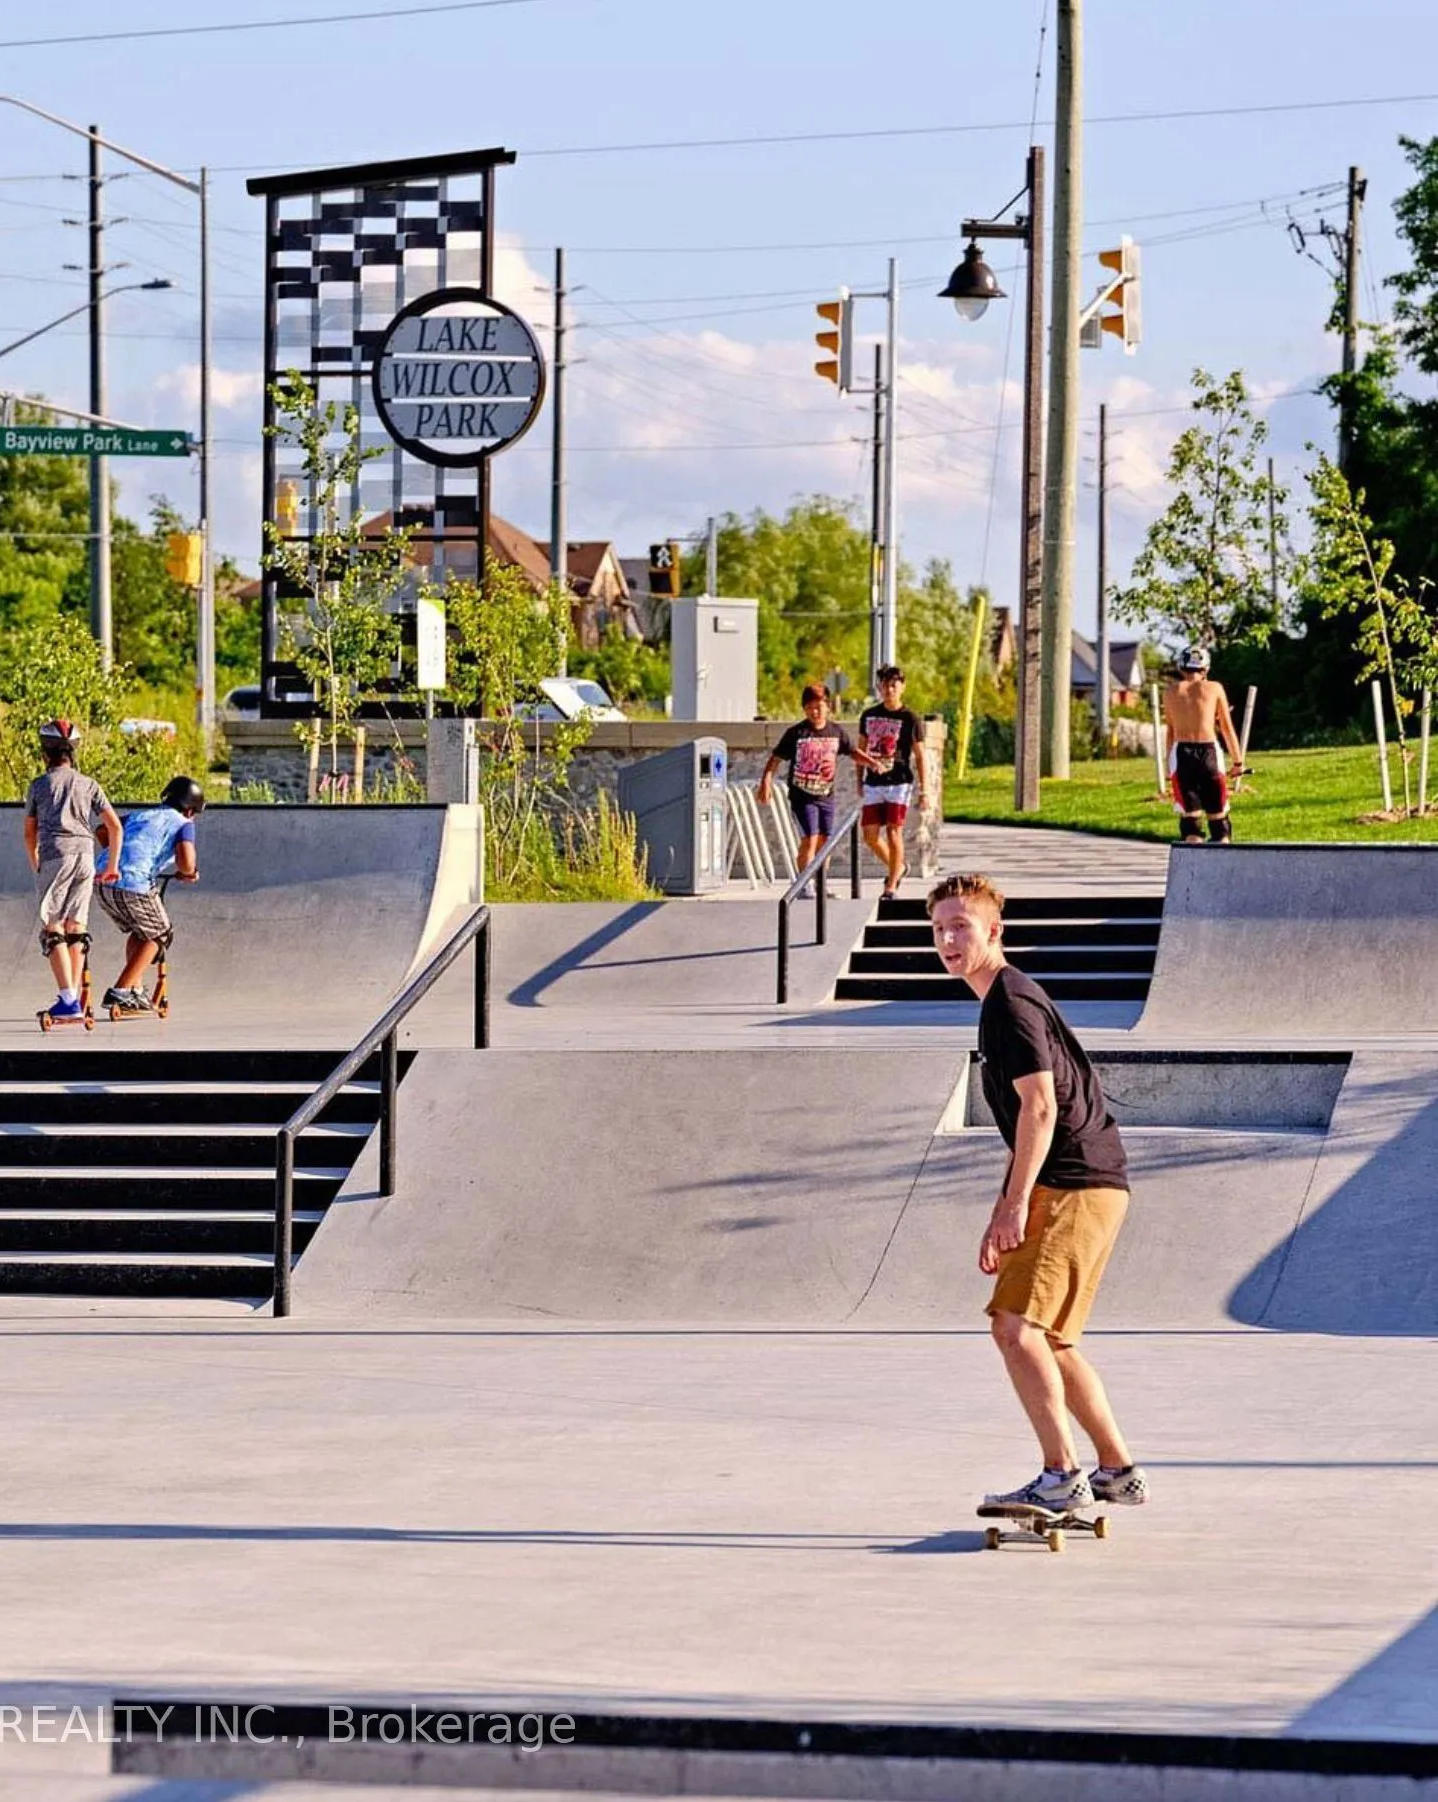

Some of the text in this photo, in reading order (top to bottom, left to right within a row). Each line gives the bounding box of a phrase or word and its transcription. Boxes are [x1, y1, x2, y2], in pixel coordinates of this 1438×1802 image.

[416, 318, 500, 351] LAKE
[392, 361, 516, 396] WILCOX
[414, 404, 500, 437] PARK
[5, 431, 159, 453] Bayview Park Lane
